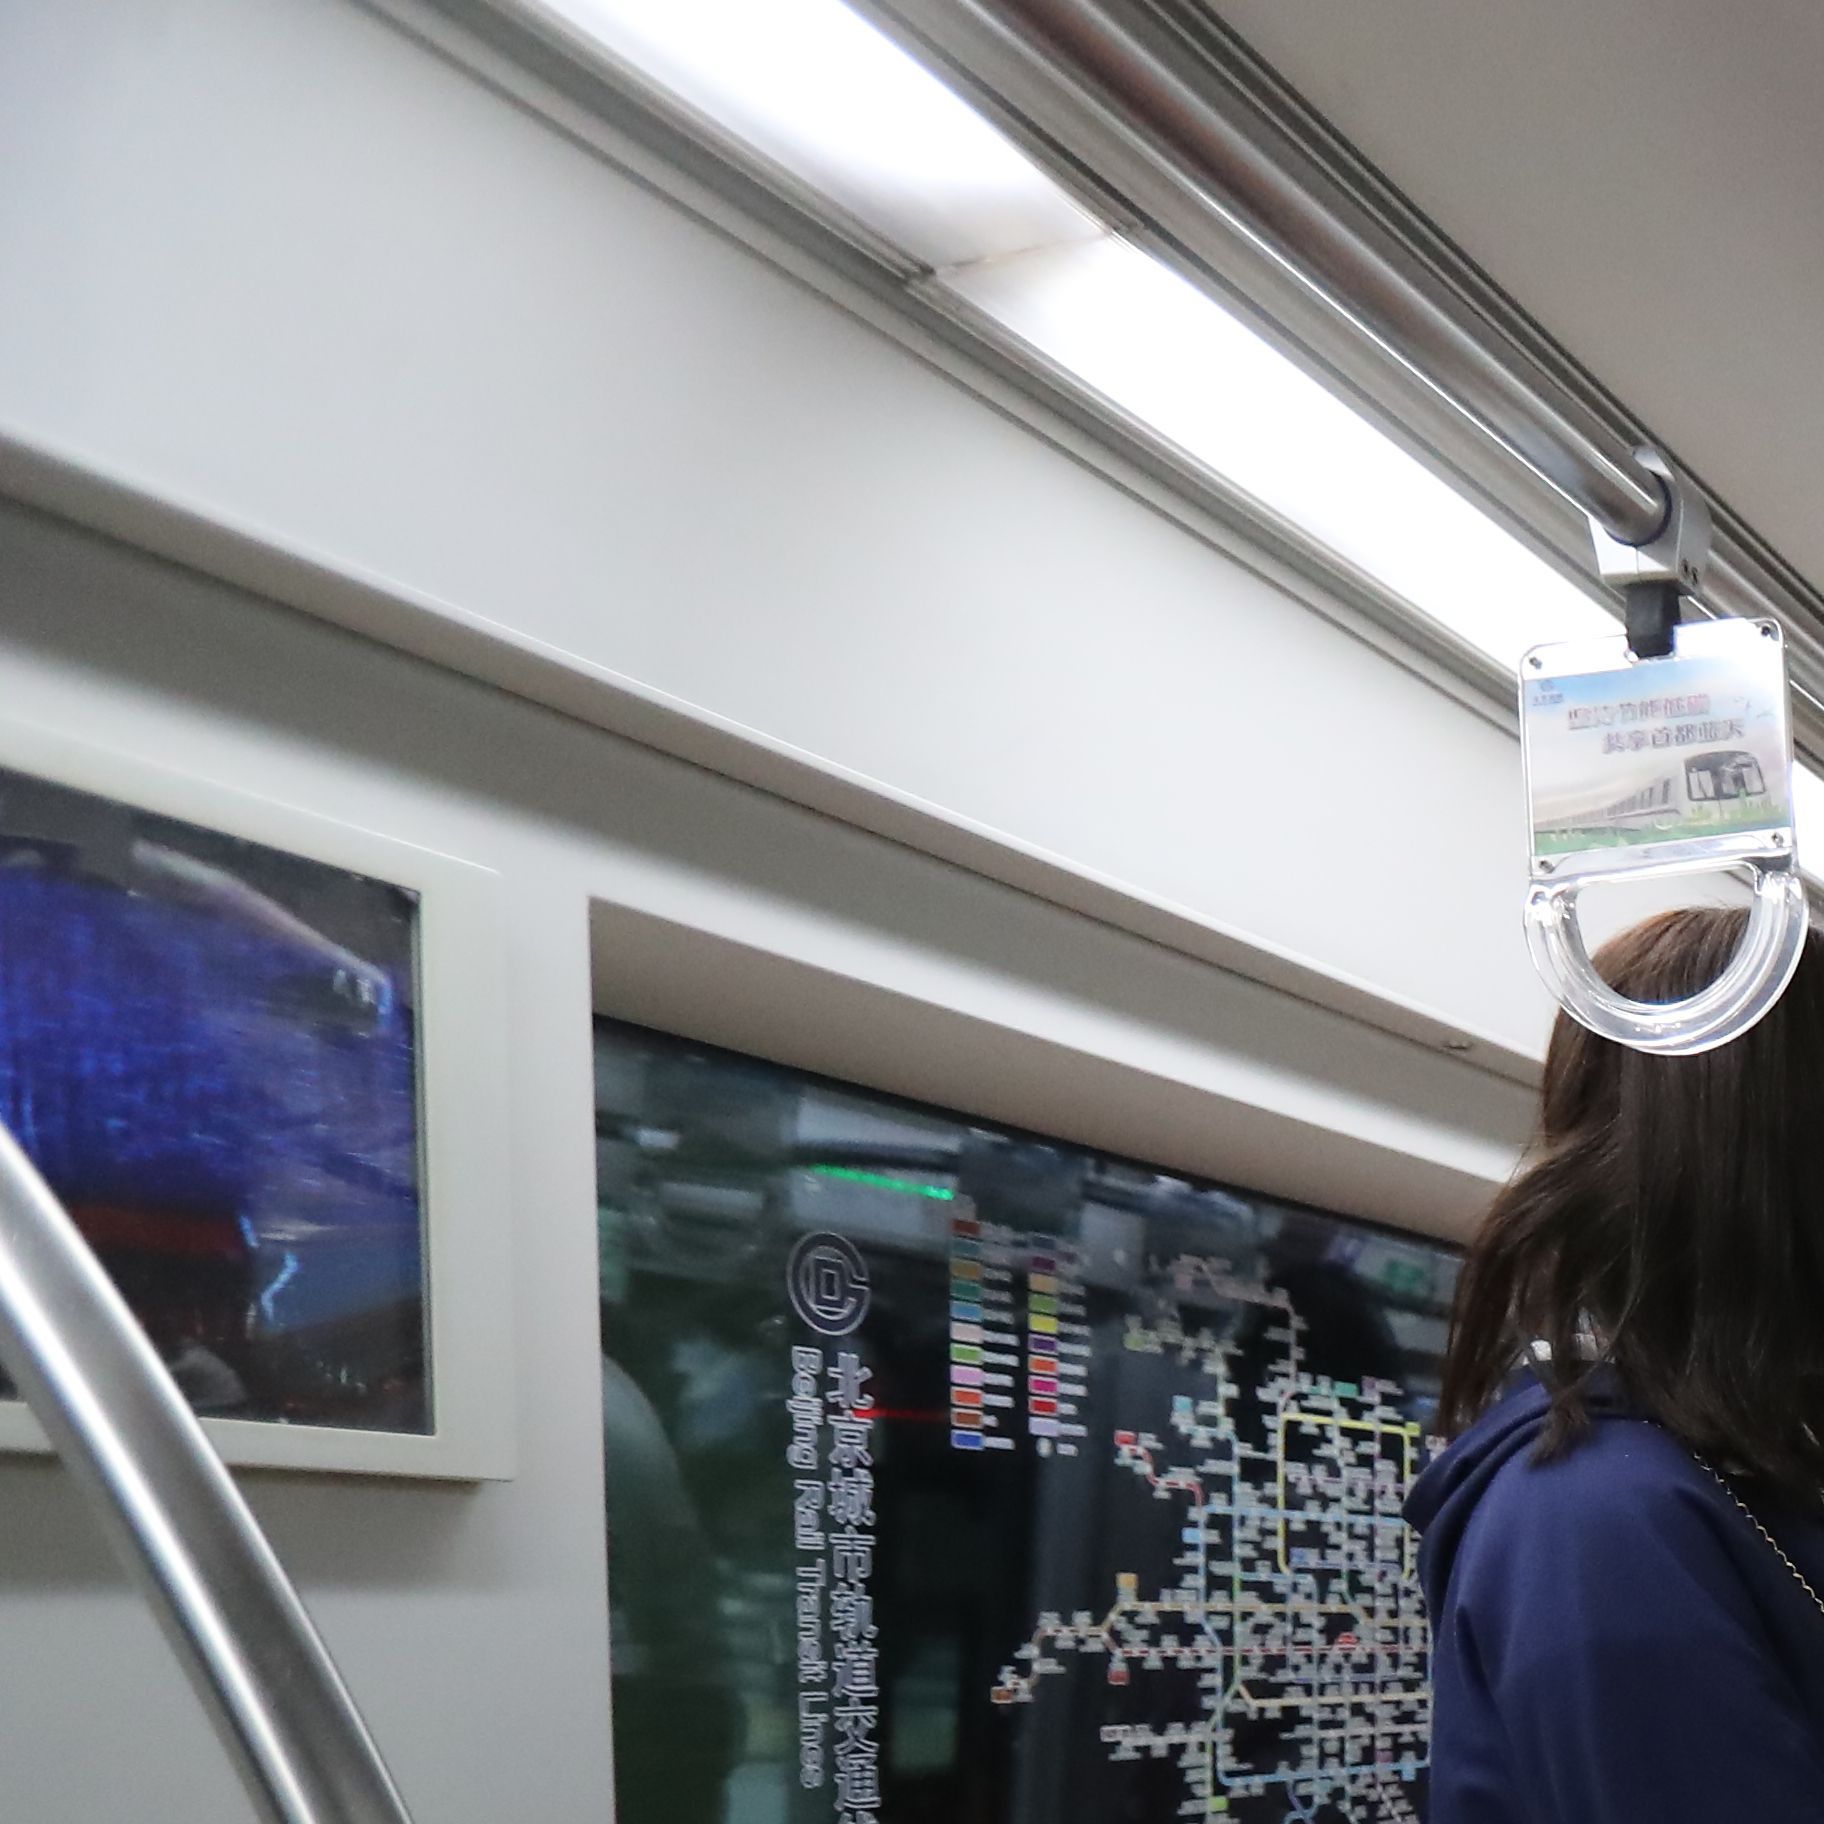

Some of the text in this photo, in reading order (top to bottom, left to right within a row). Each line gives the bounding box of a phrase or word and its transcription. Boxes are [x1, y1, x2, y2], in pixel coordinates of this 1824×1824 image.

[785, 1345, 830, 1789] Beijing Rail Transit Lines
